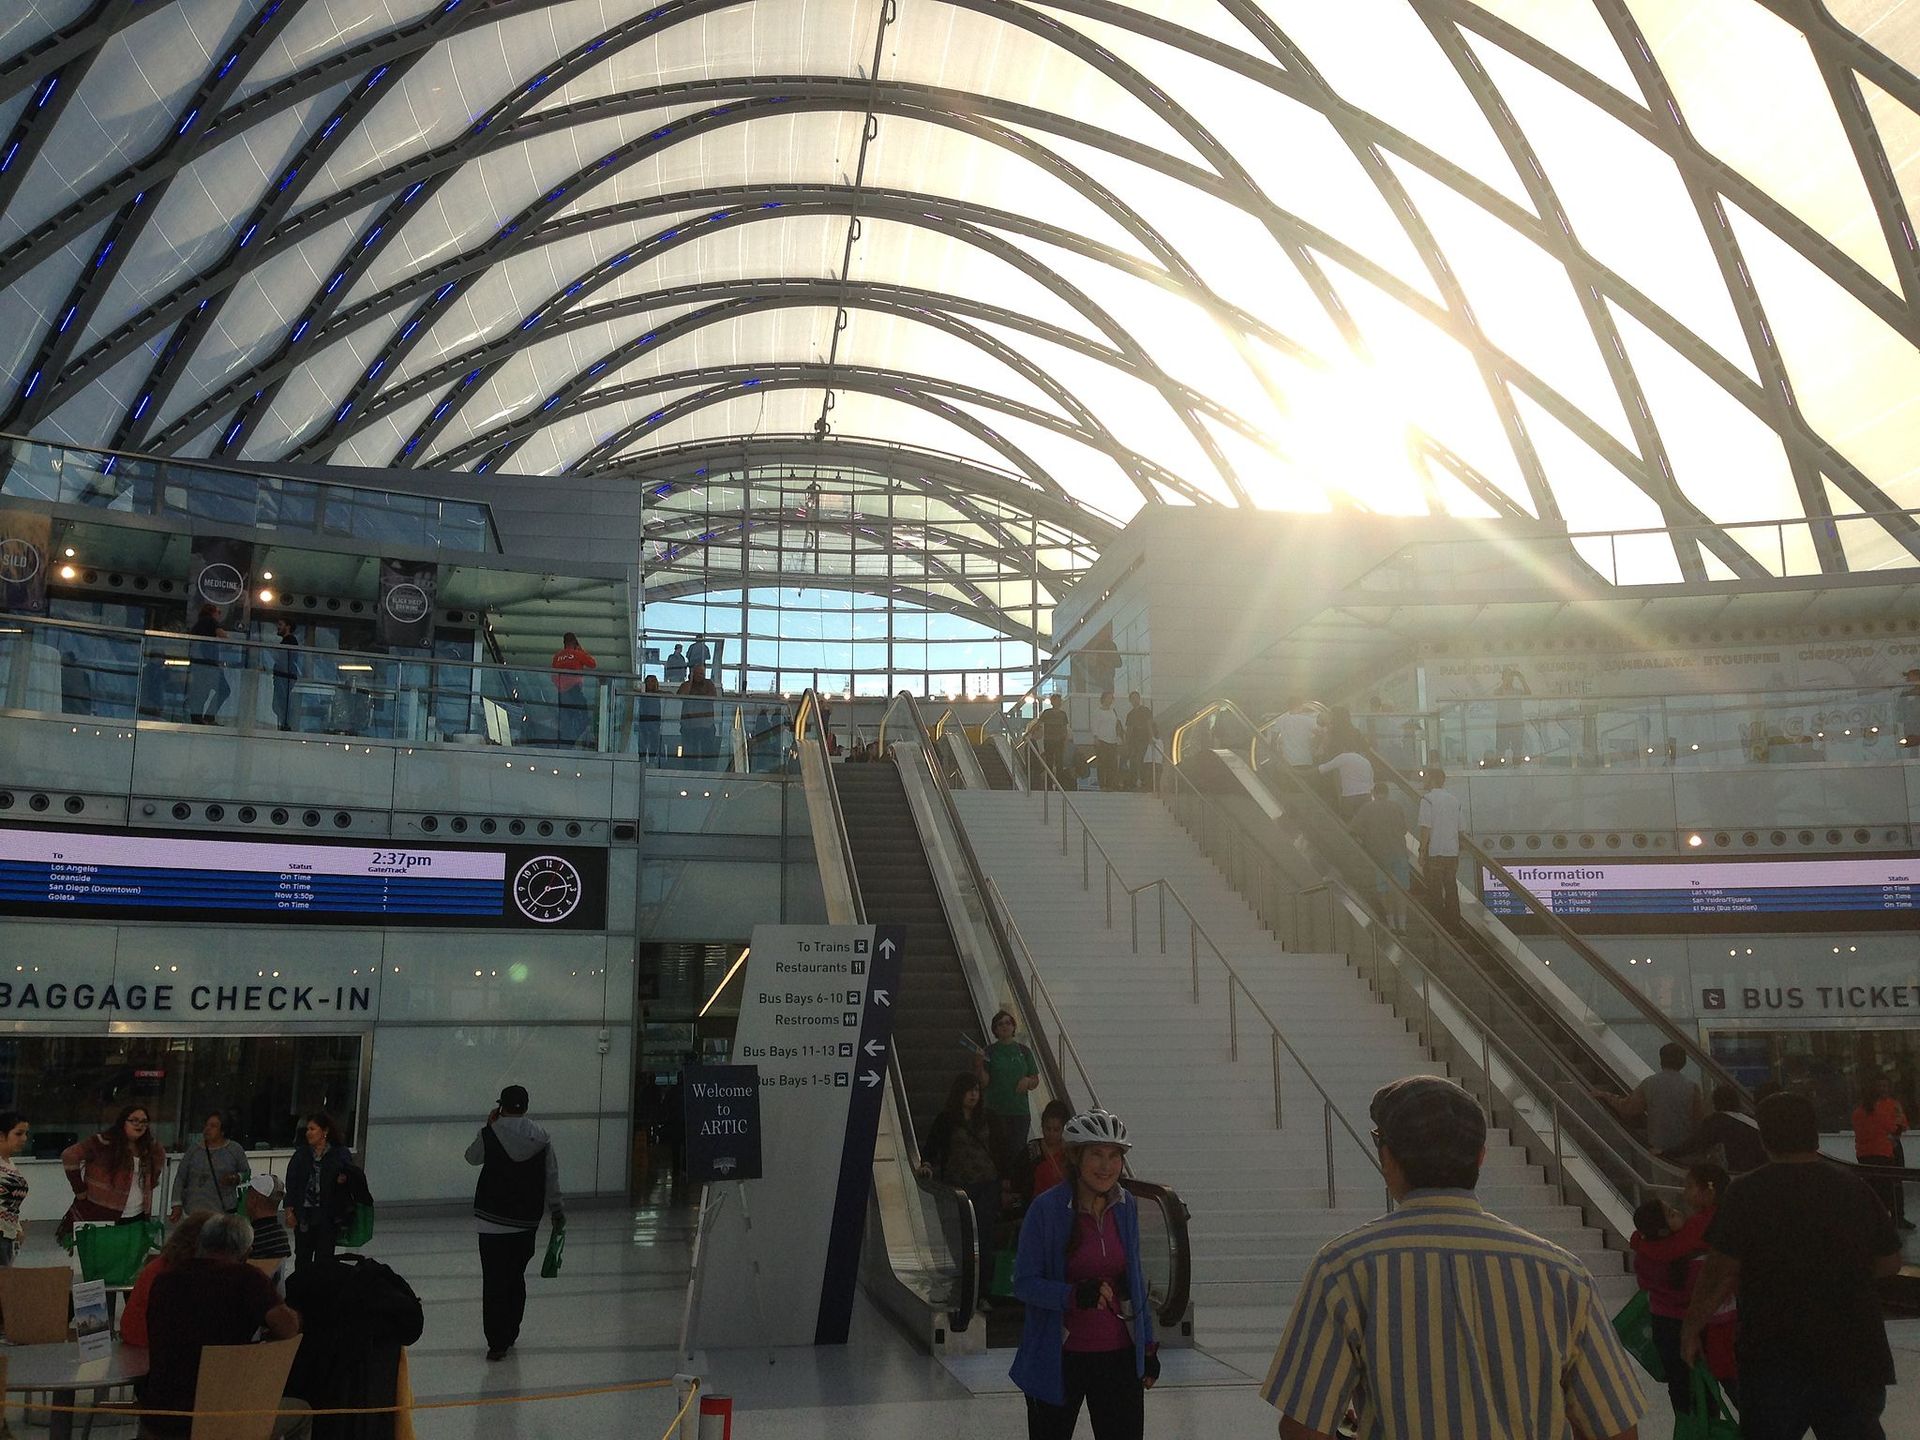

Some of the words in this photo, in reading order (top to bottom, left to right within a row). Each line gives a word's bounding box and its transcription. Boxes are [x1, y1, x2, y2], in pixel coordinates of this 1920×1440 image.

[204, 579, 238, 590] MEDICINE
[372, 852, 432, 867] 2:37pm
[50, 873, 92, 882] Oceanside
[66, 864, 99, 873] Angeles
[280, 873, 290, 881] On
[1518, 868, 1605, 881] Information
[49, 883, 64, 891] San
[65, 884, 90, 893] Diego
[91, 884, 142, 894] (Downtown)
[1579, 891, 1599, 899] Vegas
[1703, 889, 1724, 897] Vegas
[48, 893, 76, 901] Goleta
[291, 901, 310, 909] Time
[798, 942, 811, 953] To
[814, 941, 850, 953] Trains
[775, 962, 847, 973] Restaurants
[191, 986, 370, 1010] CHECK-IN
[759, 993, 782, 1004] Bus
[785, 993, 813, 1006] Bays
[816, 993, 843, 1003] 6-10
[1743, 988, 1804, 1009] BUS
[775, 1014, 839, 1025] Restrooms
[743, 1046, 766, 1057] Bus
[770, 1046, 798, 1060] Bays
[802, 1045, 835, 1056] 11-13
[779, 1074, 807, 1088] Bays
[812, 1073, 831, 1085] 1-5
[692, 1083, 753, 1097] Welcome
[717, 1104, 730, 1115] to
[700, 1119, 748, 1135] ARTIC
